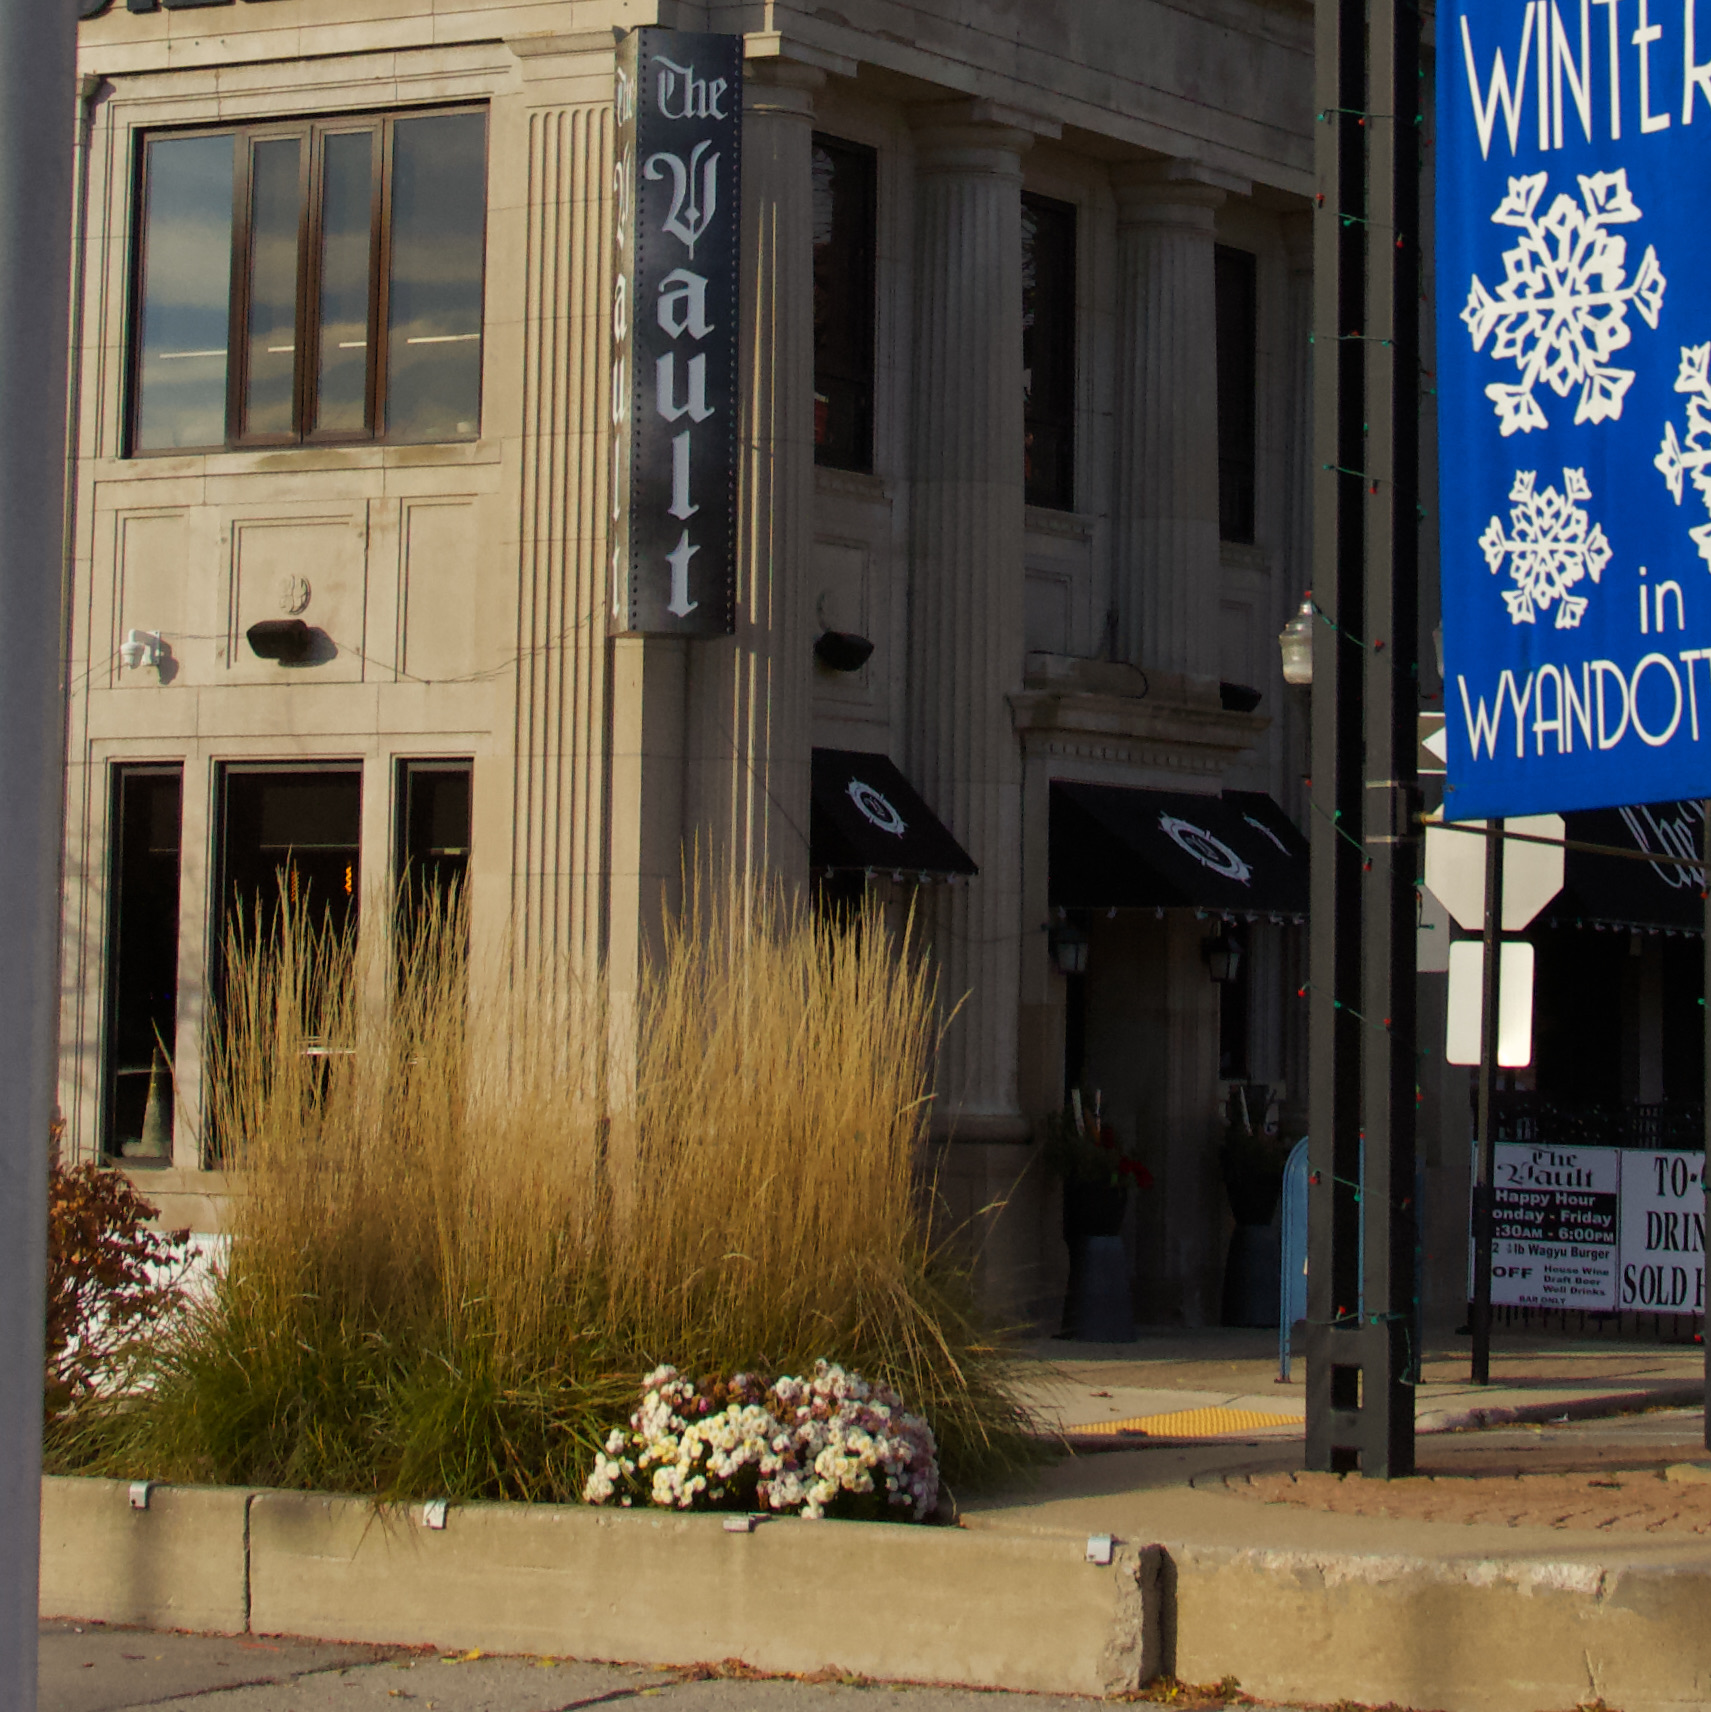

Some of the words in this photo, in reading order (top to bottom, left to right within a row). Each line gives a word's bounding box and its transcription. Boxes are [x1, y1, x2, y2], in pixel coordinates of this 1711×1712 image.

[651, 55, 729, 121] The
[643, 139, 722, 618] Vault
[1639, 566, 1686, 635] in
[1529, 1148, 1577, 1168] The
[1497, 1160, 1593, 1187] Vault
[1495, 1189, 1551, 1207] Happy
[1555, 1191, 1597, 1206] Hour
[1491, 1208, 1545, 1224] onday
[1560, 1209, 1612, 1227] Friday
[1495, 1224, 1543, 1239] :30AM
[1646, 1211, 1705, 1252] DRIN
[1528, 1244, 1567, 1259] Wagyu
[1571, 1246, 1610, 1261] Burger
[1492, 1266, 1533, 1280] OFF
[1544, 1265, 1579, 1274] House
[1582, 1267, 1609, 1276] Wine
[1544, 1275, 1572, 1284] Draft
[1575, 1277, 1601, 1286] Beer
[1622, 1264, 1687, 1306] SOLD
